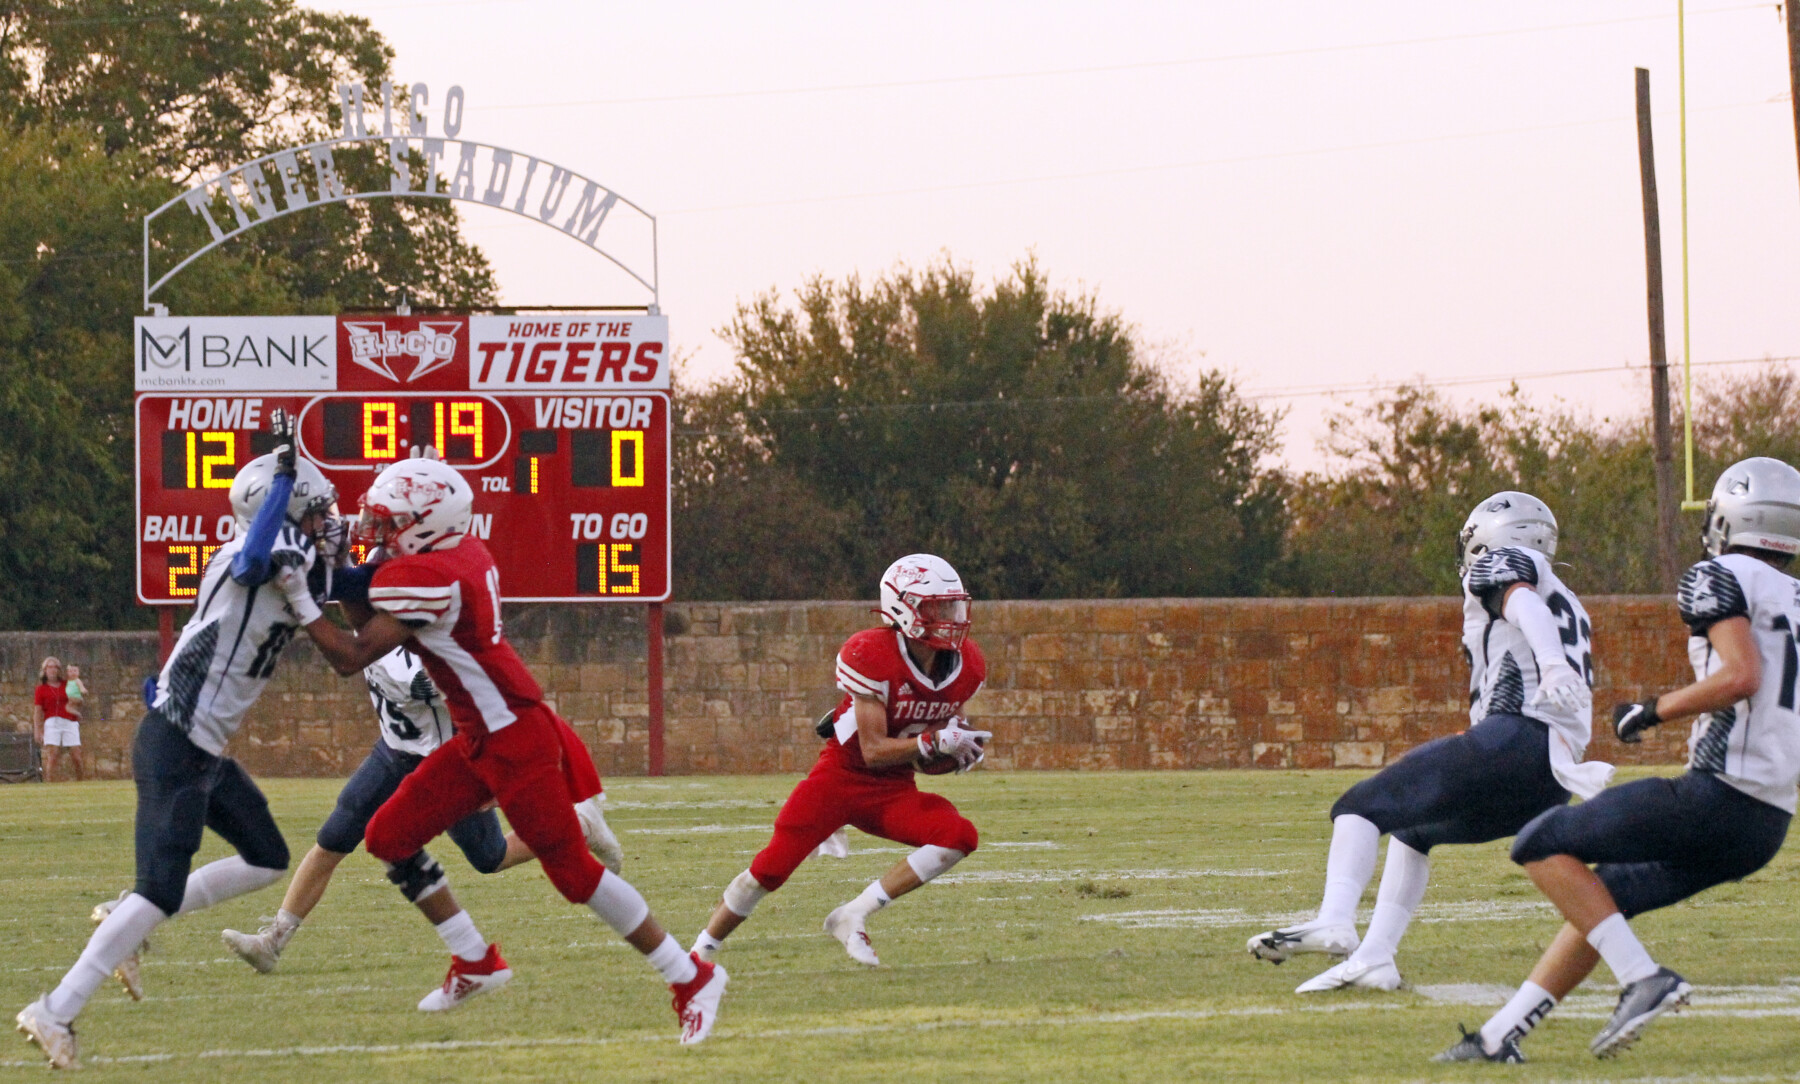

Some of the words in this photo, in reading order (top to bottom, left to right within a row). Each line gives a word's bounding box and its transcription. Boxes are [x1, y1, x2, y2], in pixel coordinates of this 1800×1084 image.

[337, 81, 464, 138] HICO
[185, 145, 343, 242] TIGER
[389, 138, 619, 247] STADIUM
[508, 322, 563, 337] HOME
[566, 322, 592, 337] OF
[596, 322, 632, 337] THE
[202, 335, 328, 368] BANK
[477, 342, 664, 383] TIGERS
[141, 375, 226, 386] mcbanktx.com
[168, 399, 263, 430] HOME
[534, 398, 653, 428] VISITOR
[186, 431, 236, 489] 12
[530, 457, 539, 493] 1
[611, 430, 644, 487] 0
[482, 477, 511, 492] TOL
[143, 515, 207, 542] BALL
[216, 515, 236, 542] O
[570, 513, 603, 539] TO
[610, 513, 648, 539] GO
[599, 543, 640, 593] 15
[1770, 613, 1800, 711] 1
[894, 700, 960, 720] TIGERS
